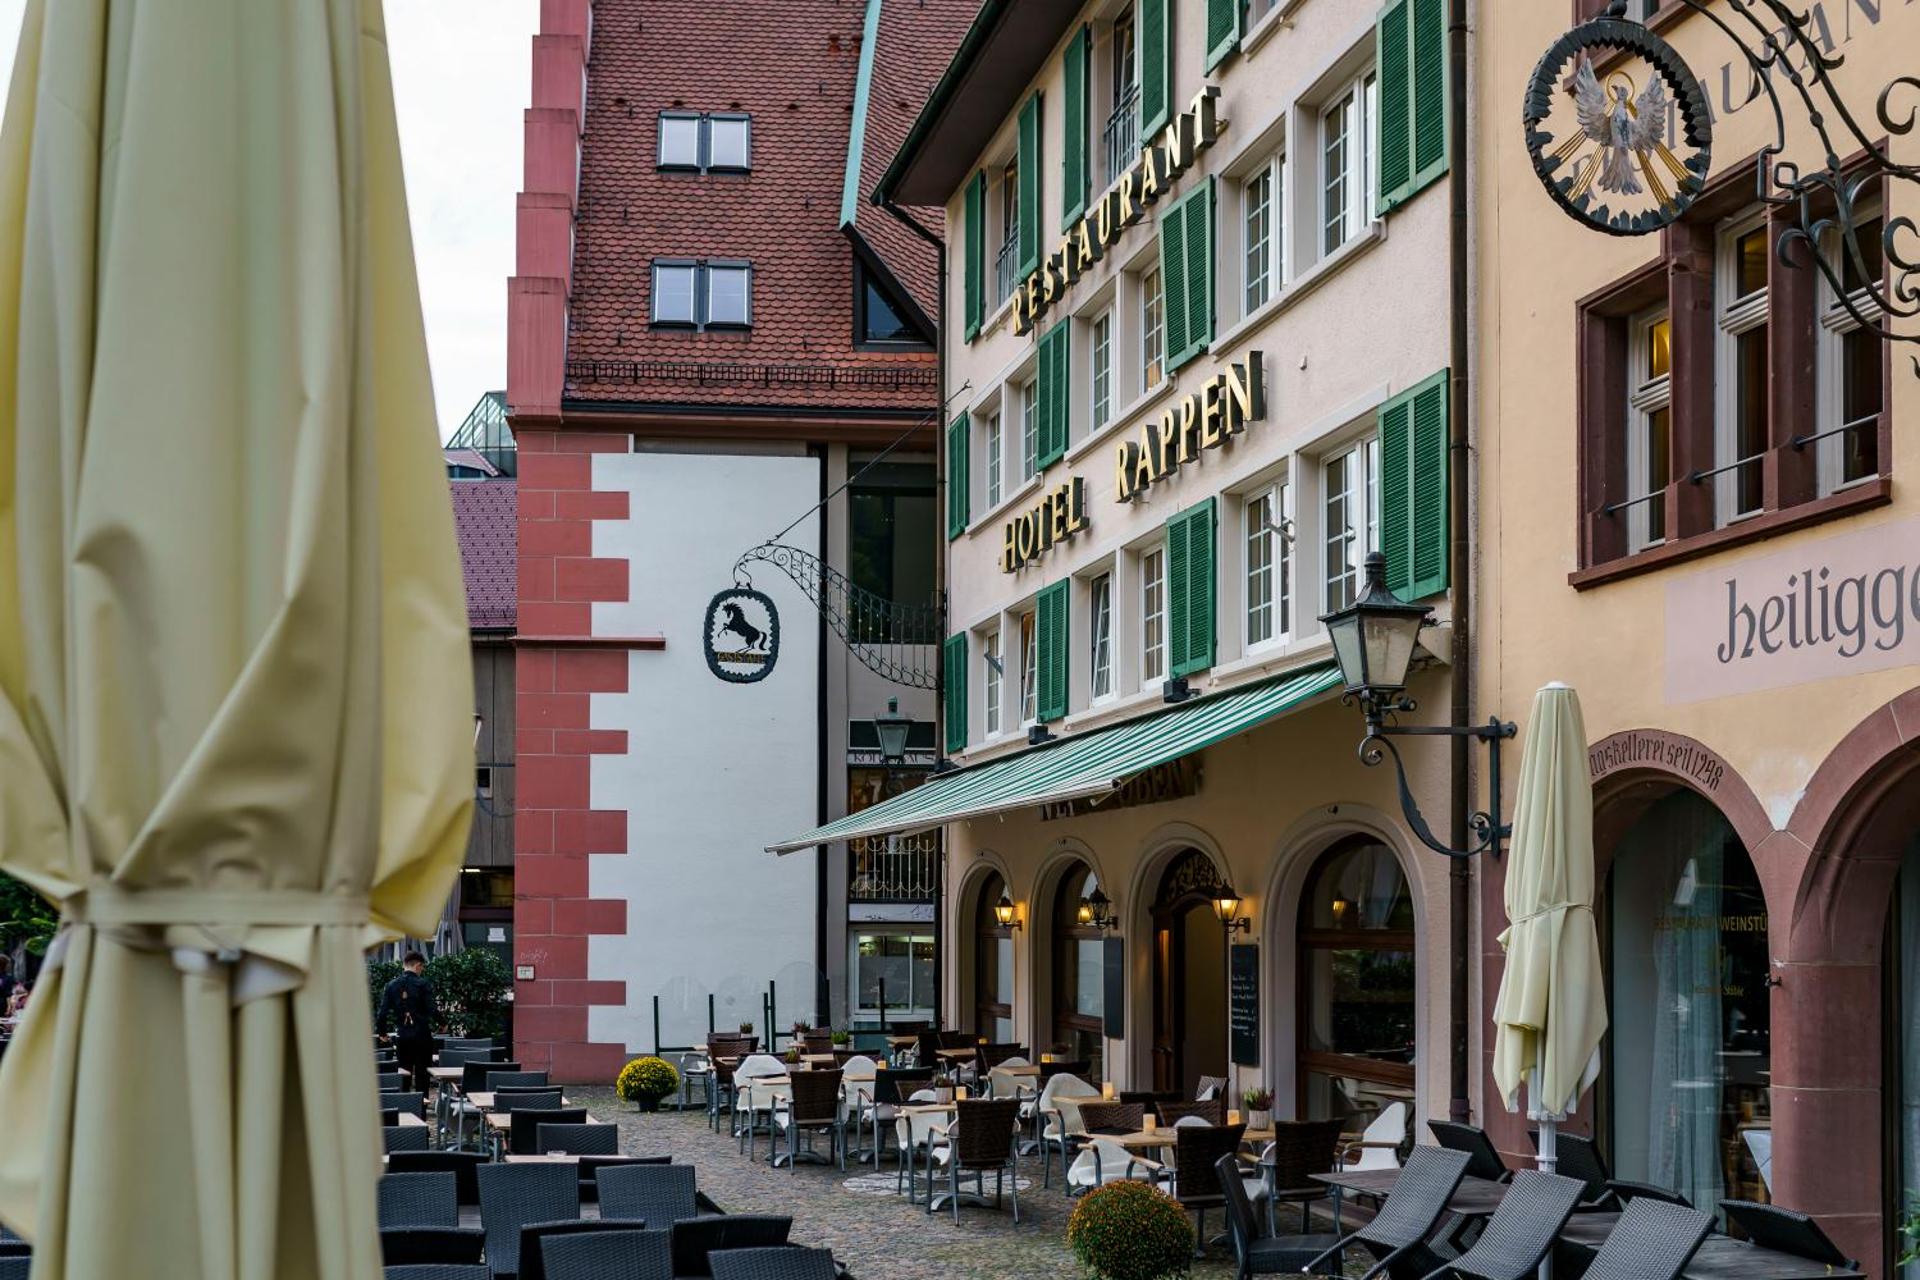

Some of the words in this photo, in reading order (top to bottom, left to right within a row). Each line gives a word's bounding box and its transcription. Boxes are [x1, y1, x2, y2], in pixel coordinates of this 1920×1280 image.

[1012, 86, 1221, 336] RESTAURANT
[1002, 476, 1090, 573] HOTEL
[1115, 350, 1264, 503] RAPPEN
[1691, 751, 1725, 792] 1298
[1720, 912, 1769, 932] WEINSTÜ
